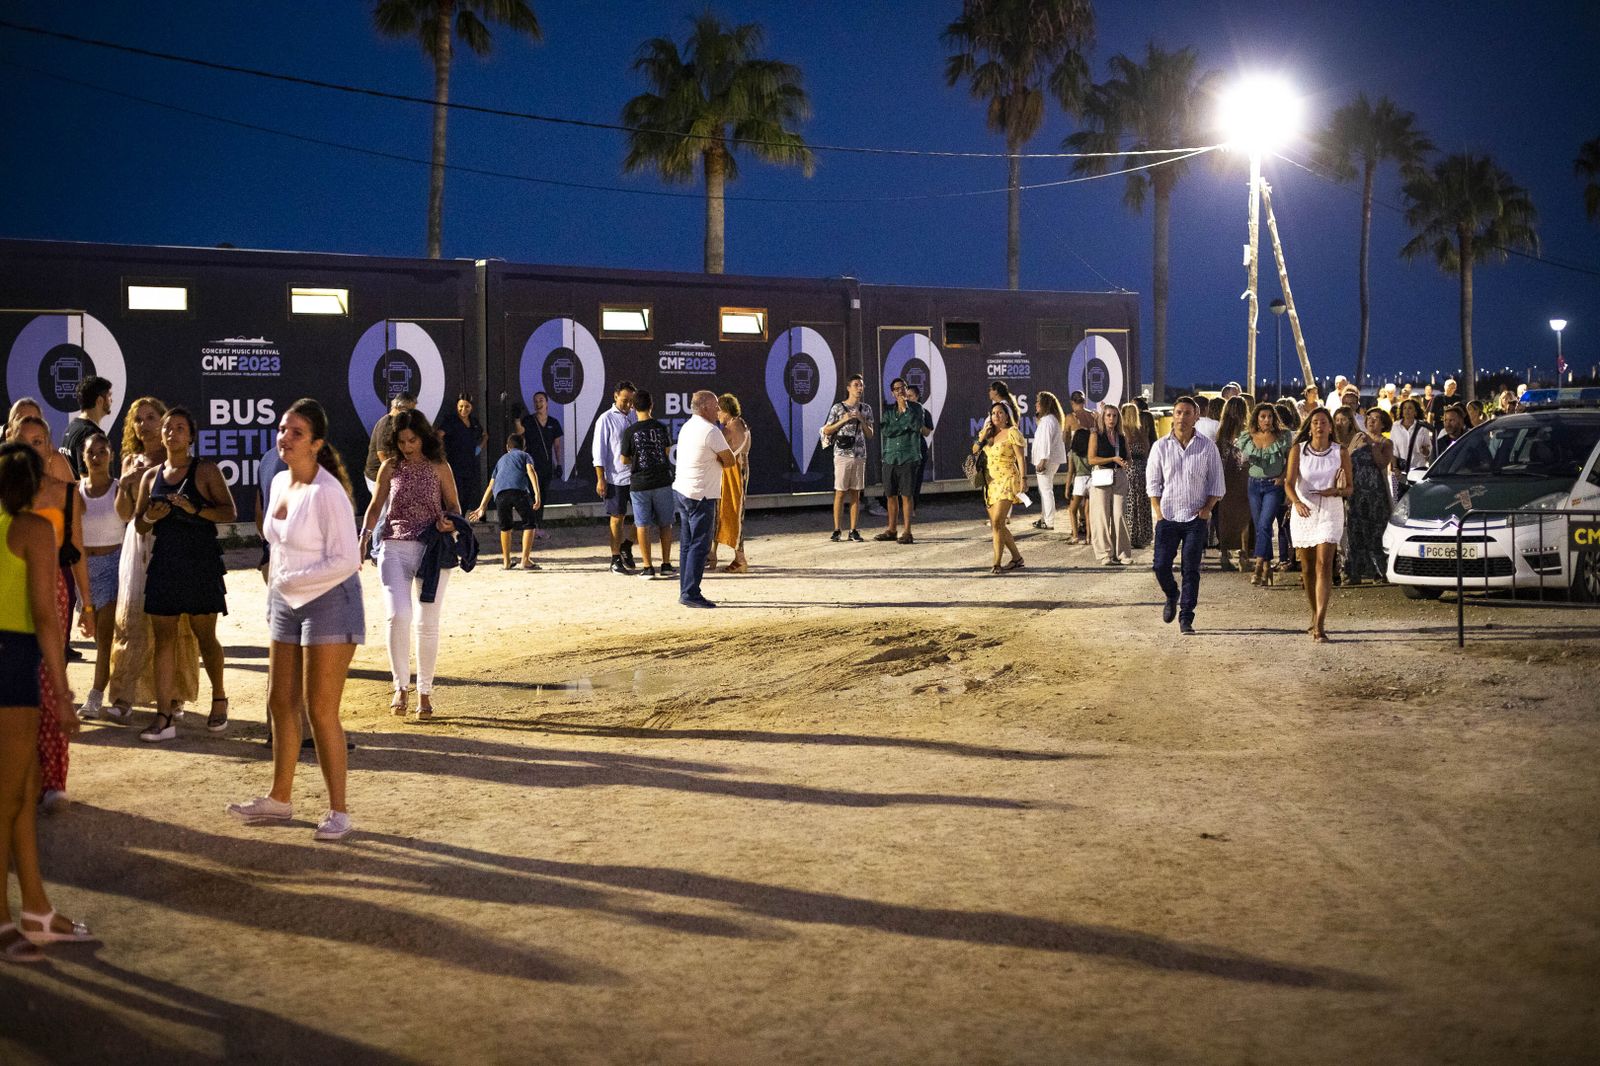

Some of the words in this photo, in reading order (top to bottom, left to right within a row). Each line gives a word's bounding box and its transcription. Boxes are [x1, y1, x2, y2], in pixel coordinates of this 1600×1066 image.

[201, 355, 281, 371] CMF2023
[658, 356, 717, 371] CMF2023
[986, 364, 1031, 376] CMF2023
[209, 398, 276, 425] BUS
[1444, 547, 1468, 558] 652
